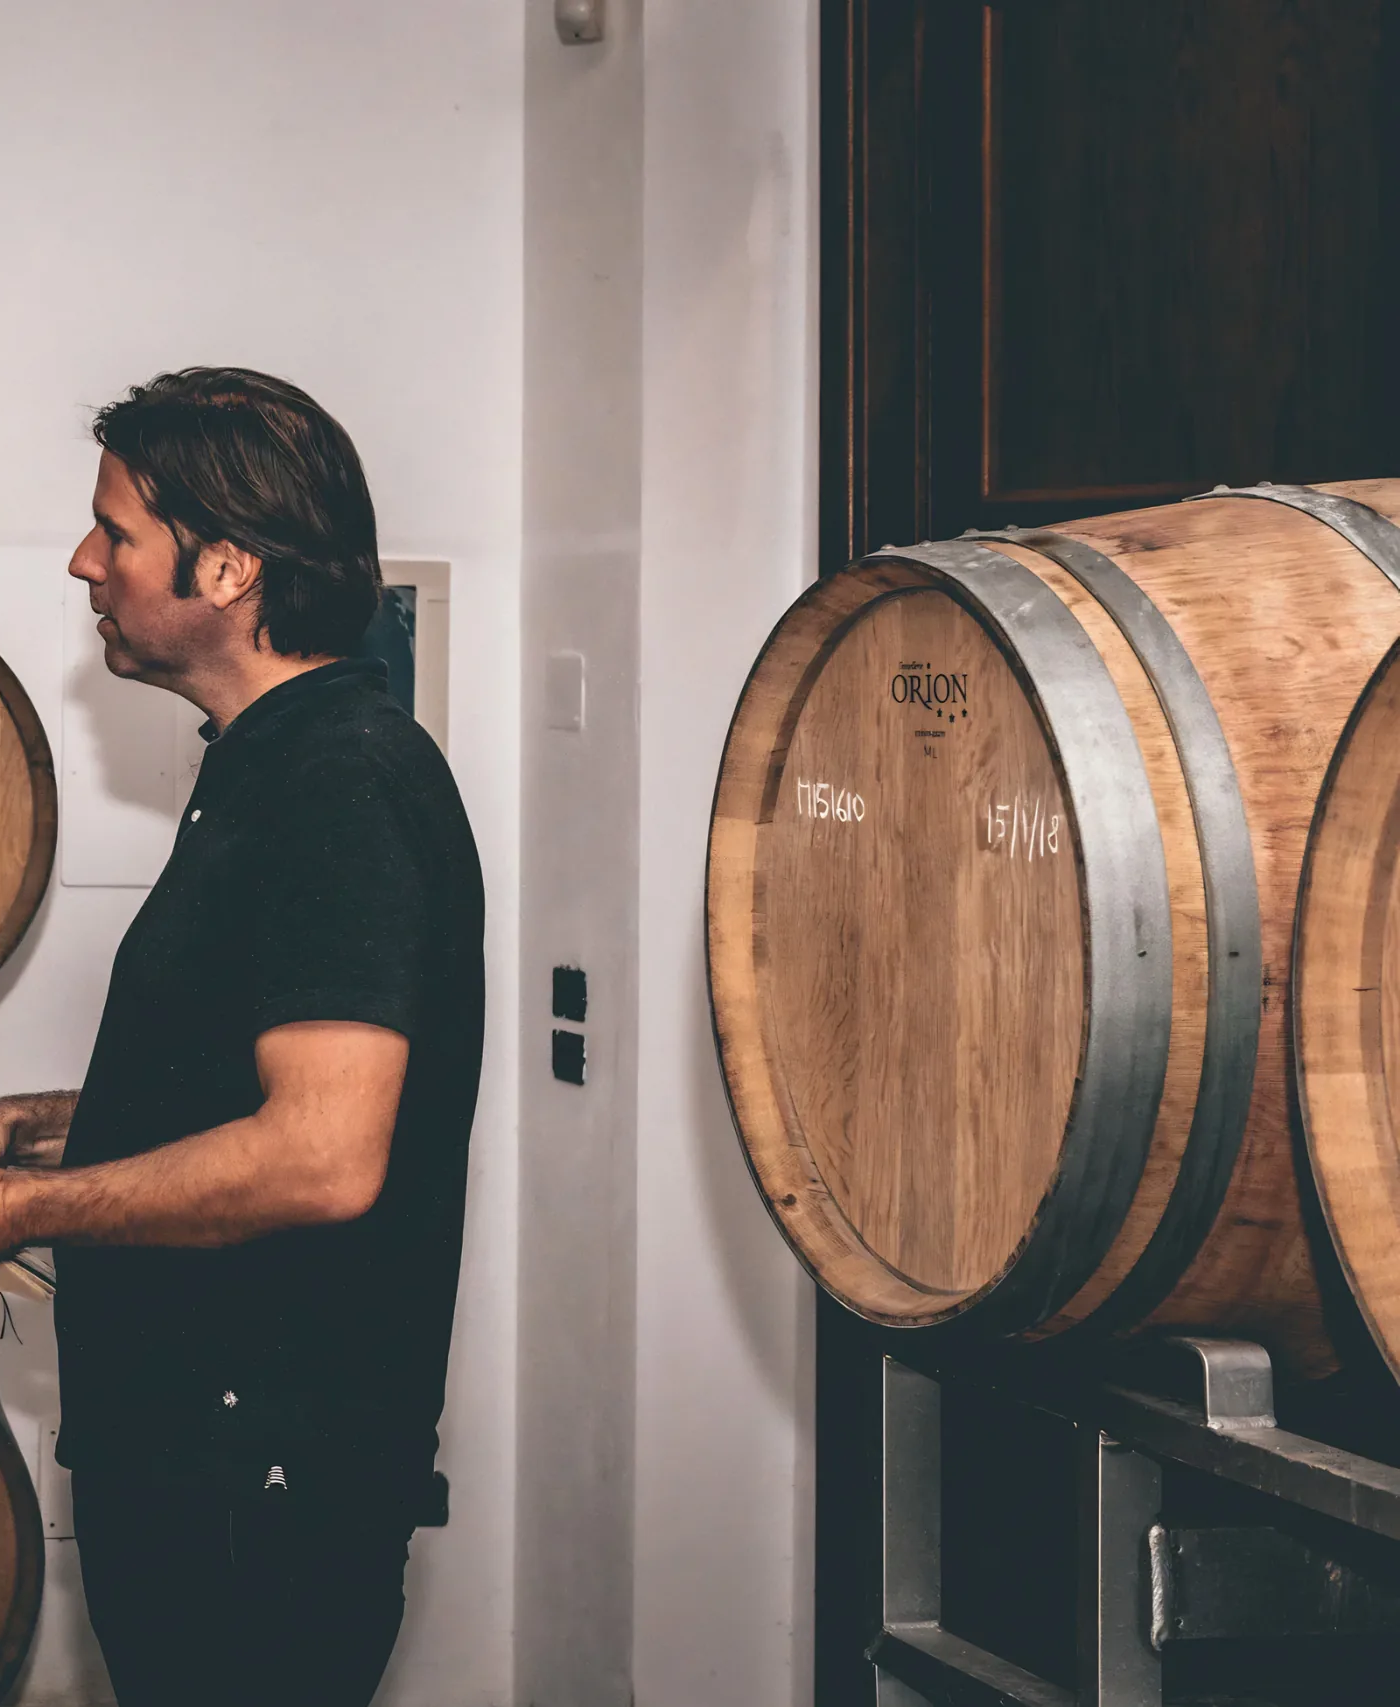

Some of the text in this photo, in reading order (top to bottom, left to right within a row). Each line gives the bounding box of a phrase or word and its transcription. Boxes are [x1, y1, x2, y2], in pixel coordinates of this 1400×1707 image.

[891, 672, 968, 711] ORION
[797, 776, 865, 822] M151610
[987, 795, 1060, 863] 15/1/18
